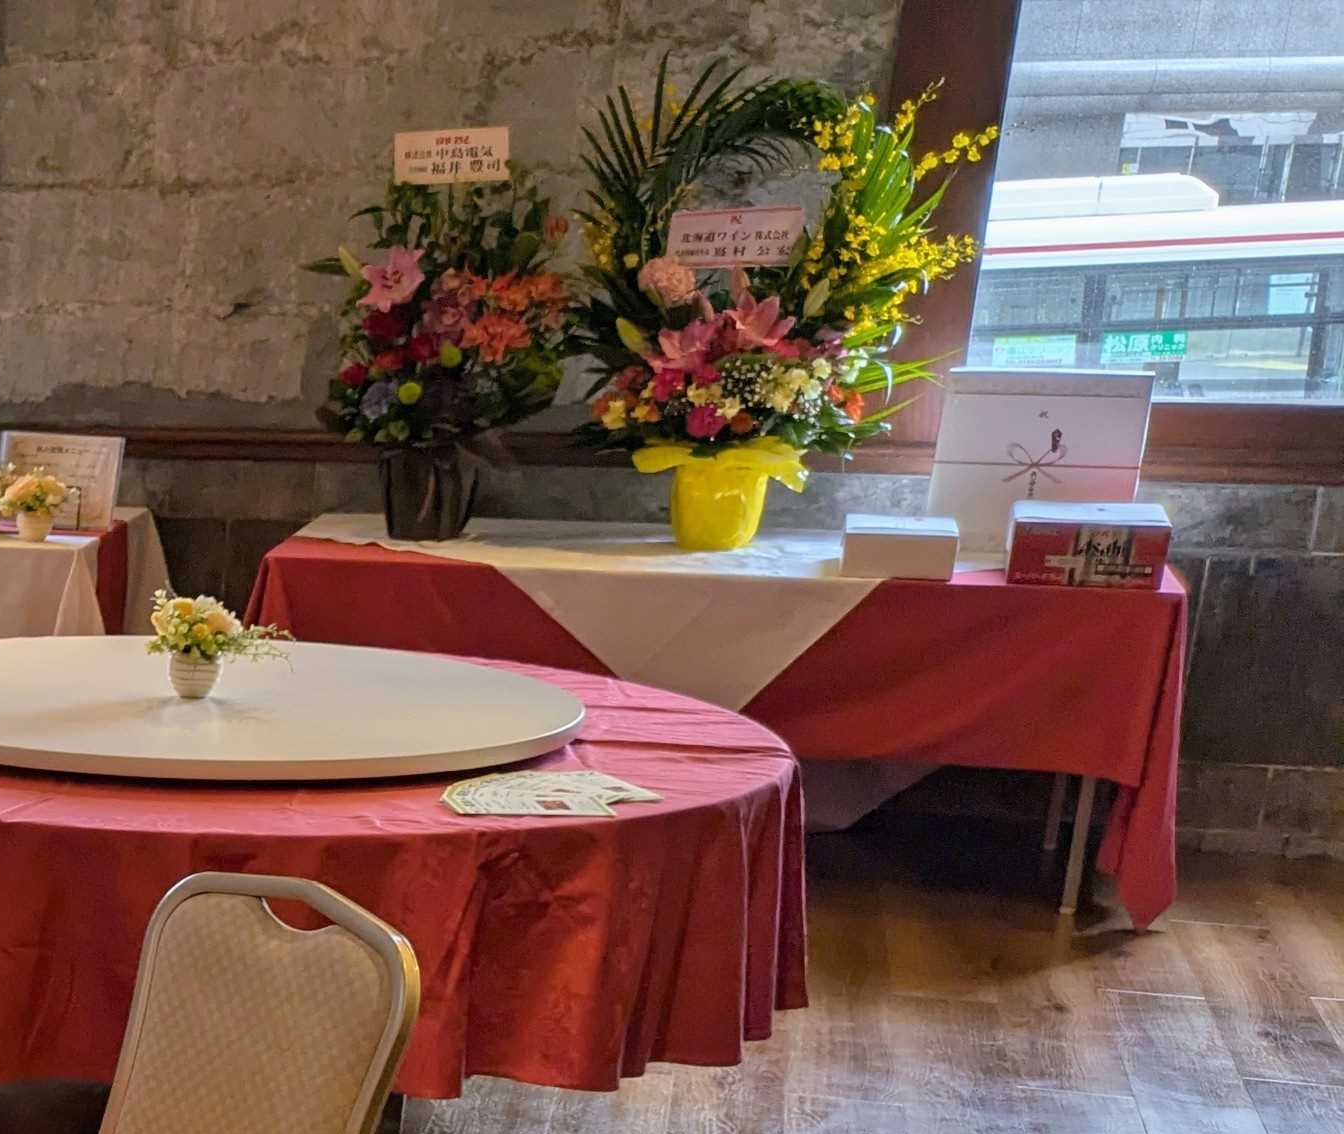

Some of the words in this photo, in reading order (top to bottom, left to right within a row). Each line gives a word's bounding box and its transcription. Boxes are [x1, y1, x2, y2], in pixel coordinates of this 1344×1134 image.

[681, 229, 751, 243] 北海道ワイン
